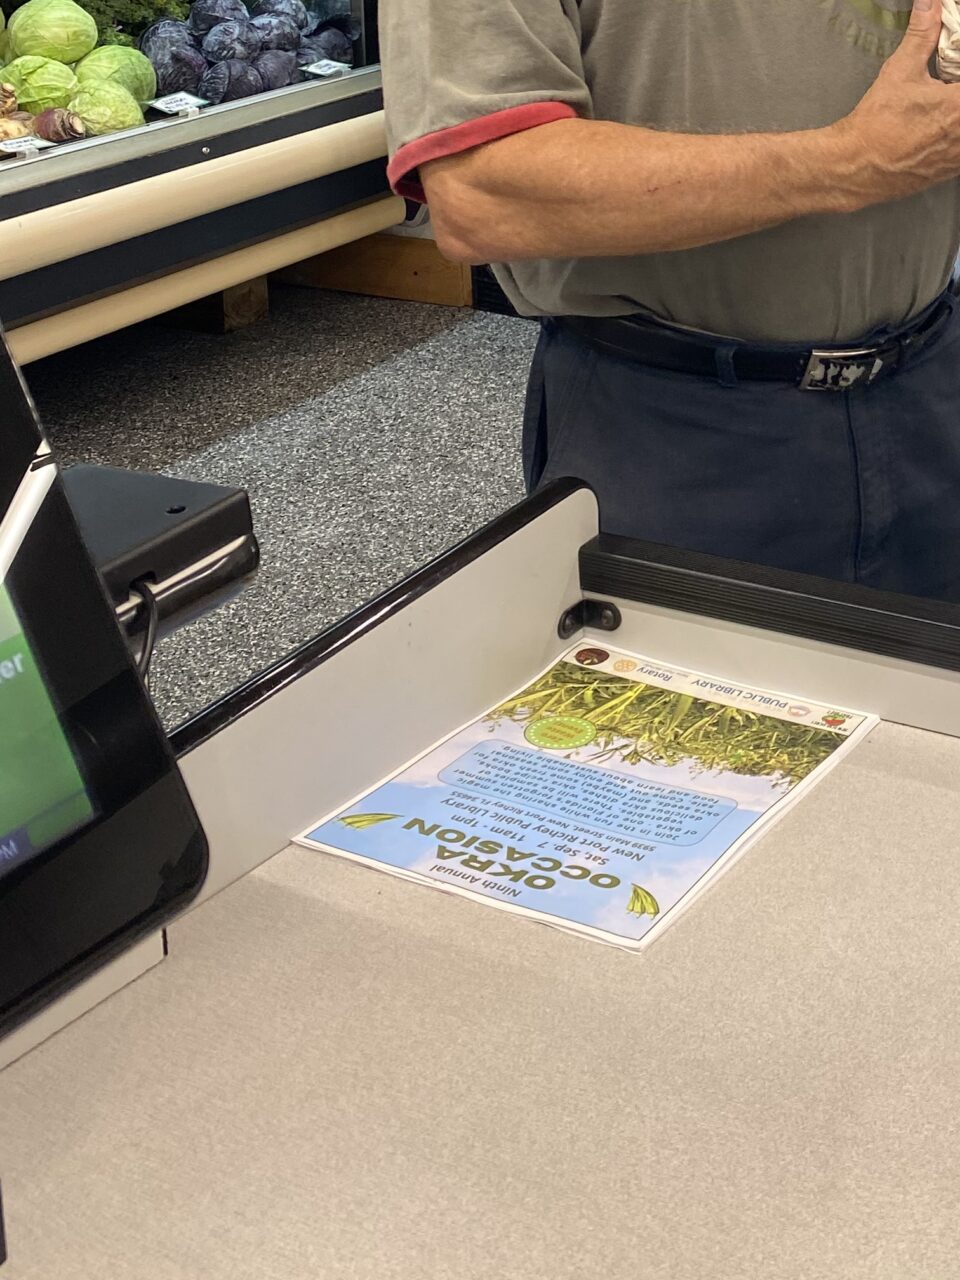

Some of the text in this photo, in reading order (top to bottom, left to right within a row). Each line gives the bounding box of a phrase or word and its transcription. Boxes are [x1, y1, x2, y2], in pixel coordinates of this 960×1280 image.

[636, 665, 673, 682] Rotary
[690, 678, 788, 709] PUBLIC LIBRARY
[490, 749, 538, 766] seasonal
[491, 756, 516, 767] okra
[518, 764, 547, 776] fresh
[535, 755, 599, 776] sustainable
[540, 763, 570, 774] some
[452, 768, 498, 784] summer
[493, 772, 539, 787] samples
[512, 770, 548, 783] recipe
[548, 772, 579, 784] some
[572, 770, 603, 783] enjoy
[600, 771, 634, 784] about
[456, 776, 490, 790] magic
[540, 784, 556, 793] be
[550, 779, 576, 790] okra
[580, 780, 627, 798] (maybe)
[603, 780, 627, 790] and
[635, 782, 666, 793] learn
[491, 787, 512, 796] the
[499, 781, 553, 800] forgotten
[556, 789, 579, 799] will
[628, 787, 649, 796] out
[666, 789, 690, 797] and
[479, 797, 492, 806] FL
[513, 791, 557, 808] sharing
[581, 796, 613, 810] There
[627, 795, 652, 804] and
[651, 792, 684, 803] Come
[691, 793, 719, 804] food
[490, 800, 524, 815] Richey
[555, 796, 605, 815] Florida's
[621, 800, 647, 811] okra
[523, 810, 547, 822] Port
[558, 805, 590, 819] while
[650, 804, 703, 821] delicious
[693, 807, 720, 817] okra
[449, 813, 479, 828] 1pm
[547, 817, 570, 829] New
[592, 816, 613, 826] fun
[621, 816, 644, 825] one
[439, 797, 645, 862] New Port Richey Public Library
[615, 822, 636, 832] the
[655, 823, 682, 832] okra
[489, 825, 525, 842] 11am
[653, 830, 680, 841] Join
[536, 840, 549, 848] 7
[604, 834, 631, 846] Main
[403, 817, 620, 888] OCCASION
[552, 842, 581, 857] Sep.
[584, 851, 610, 866] Sat,
[436, 844, 555, 890] OKRA
[428, 863, 522, 897] Ninth Annual
